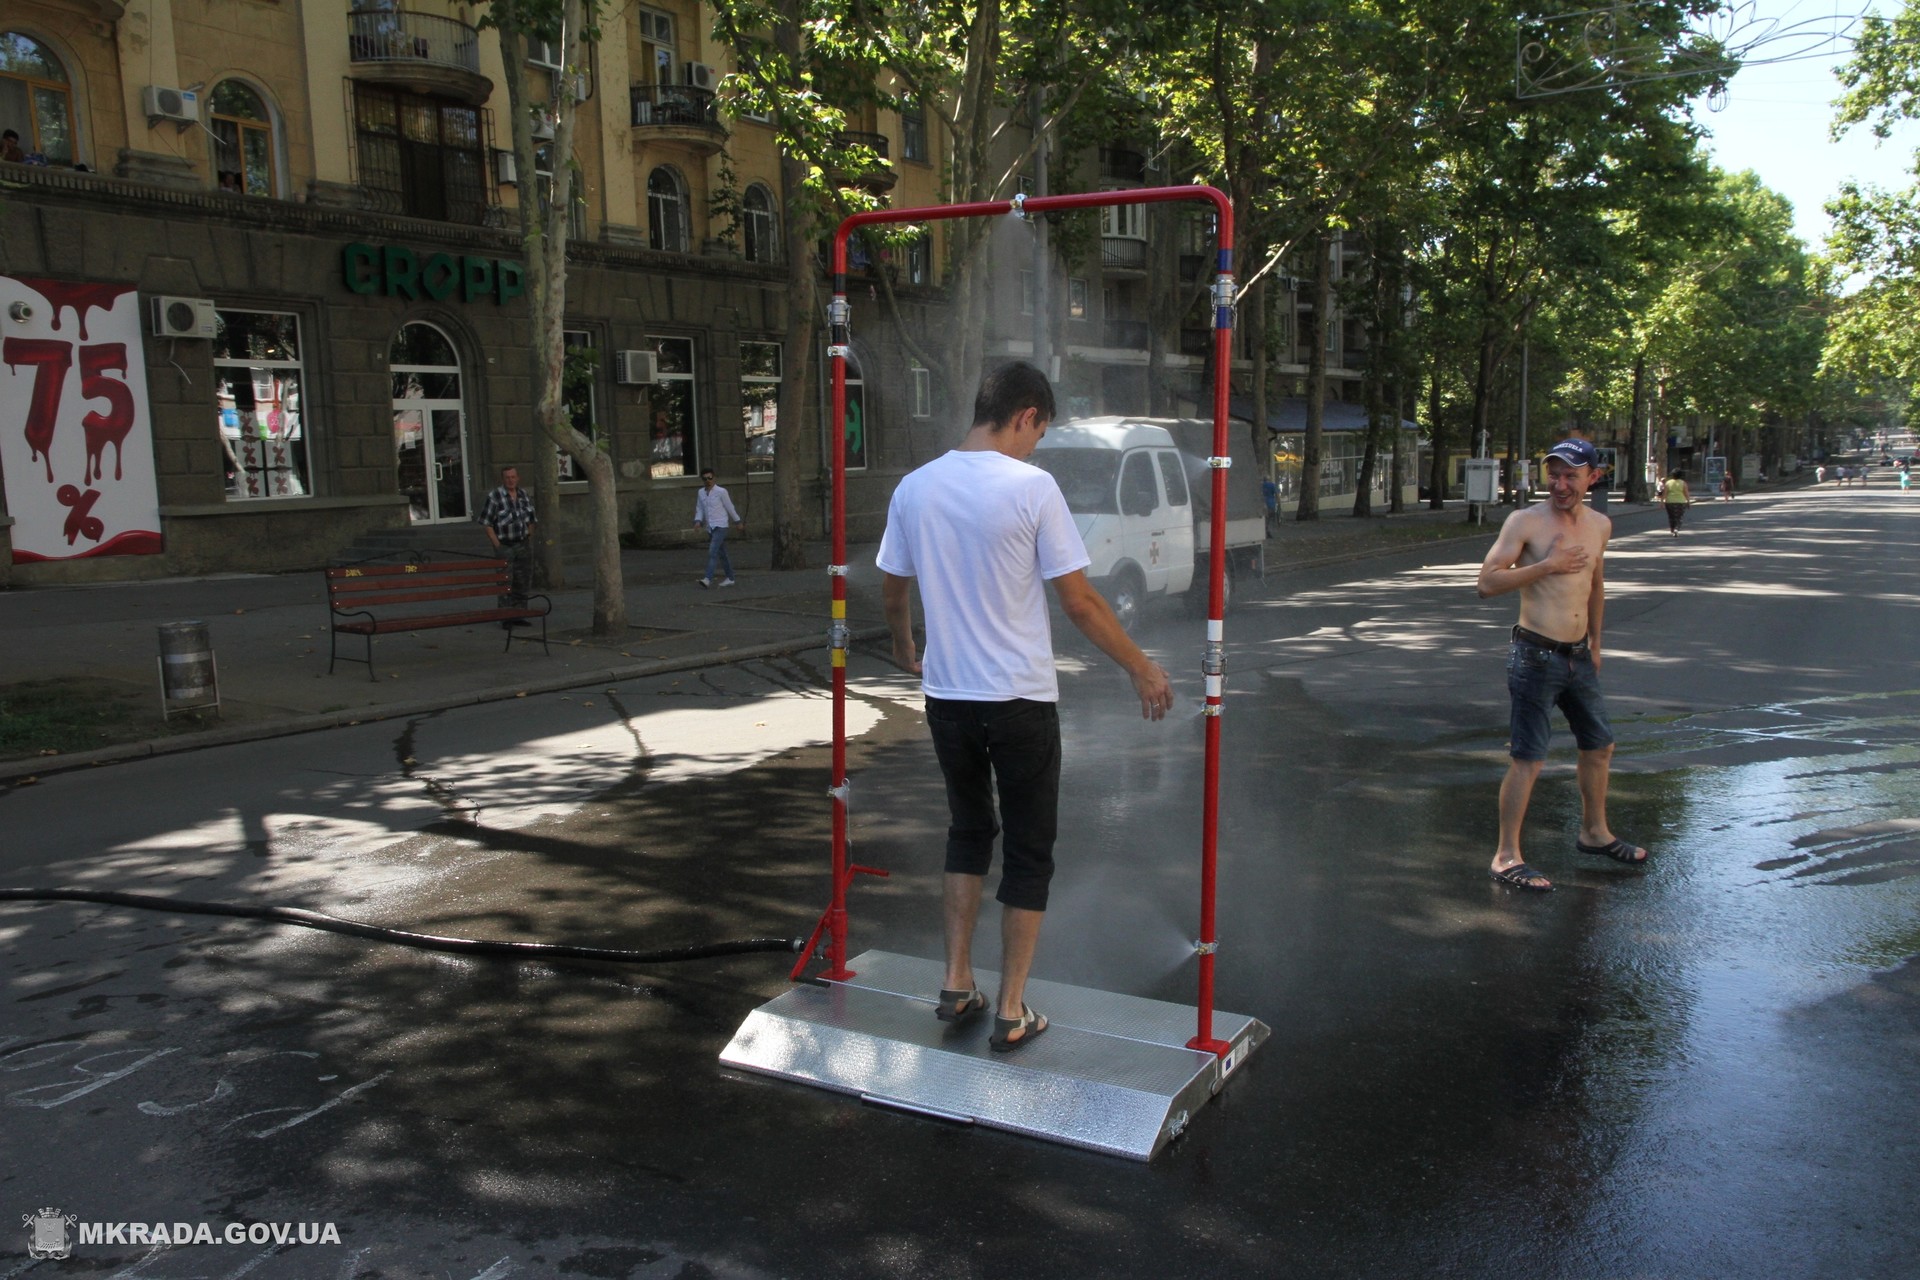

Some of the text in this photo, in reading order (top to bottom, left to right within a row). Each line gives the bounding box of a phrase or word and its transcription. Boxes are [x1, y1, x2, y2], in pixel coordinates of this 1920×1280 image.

[343, 241, 526, 305] CROPP
[3, 337, 135, 486] 75
[56, 484, 105, 546] %
